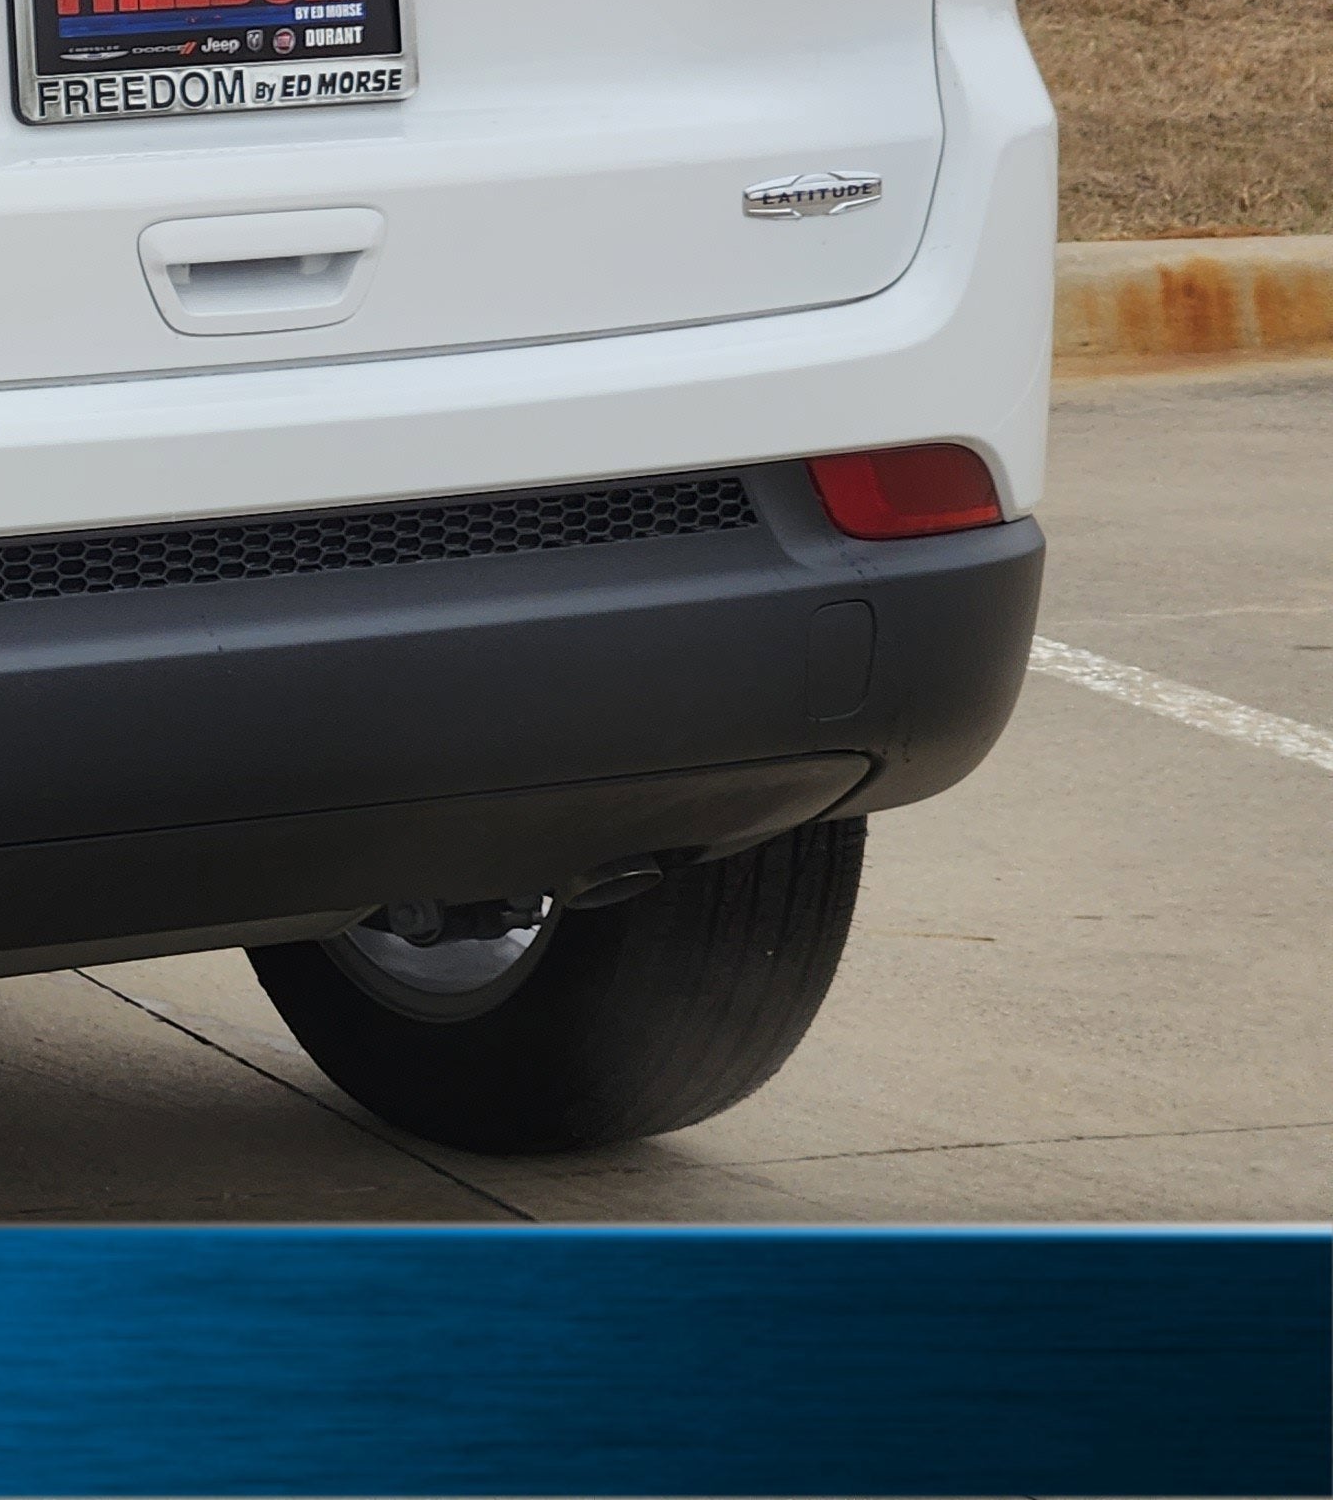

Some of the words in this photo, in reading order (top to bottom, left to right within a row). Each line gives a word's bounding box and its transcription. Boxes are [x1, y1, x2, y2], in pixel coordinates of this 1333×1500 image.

[294, 5, 309, 20] BY
[310, 5, 324, 18] ED
[325, 3, 364, 17] MORSE
[201, 37, 241, 54] Jeep
[304, 25, 365, 47] DURANT
[37, 70, 246, 117] FREEDOM
[281, 74, 312, 98] ED
[316, 68, 403, 96] MORSE
[762, 182, 874, 205] LATITUDE
